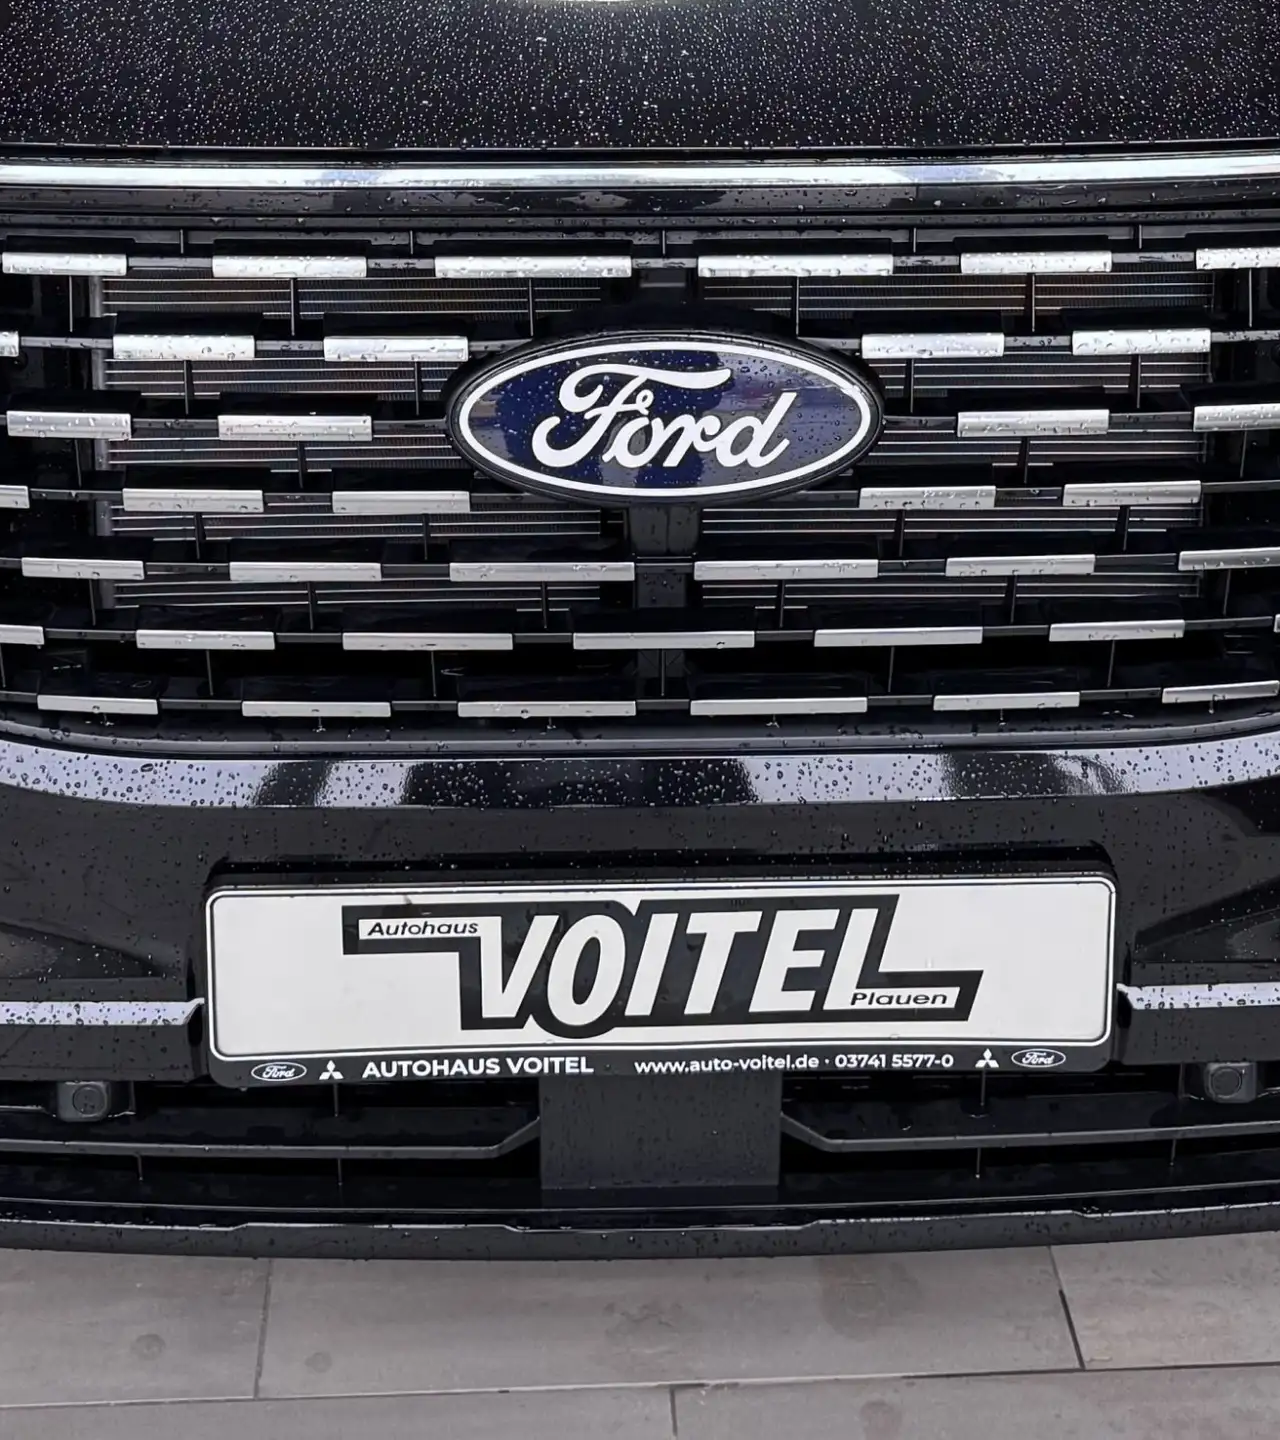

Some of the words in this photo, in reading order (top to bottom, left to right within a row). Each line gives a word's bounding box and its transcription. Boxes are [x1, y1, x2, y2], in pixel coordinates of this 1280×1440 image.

[532, 363, 795, 469] Ford
[366, 919, 479, 937] Autohaus
[481, 907, 884, 1026] VOITEL
[851, 990, 948, 1008] Plauen
[362, 1058, 501, 1079] AUTOHAUS
[505, 1056, 595, 1075] VOITEL
[634, 1054, 820, 1074] www.auto-voitel.de
[834, 1053, 887, 1069] 03741
[891, 1053, 955, 1069] 5577-0
[1021, 1050, 1055, 1066] Ford
[261, 1064, 296, 1079] Ford
